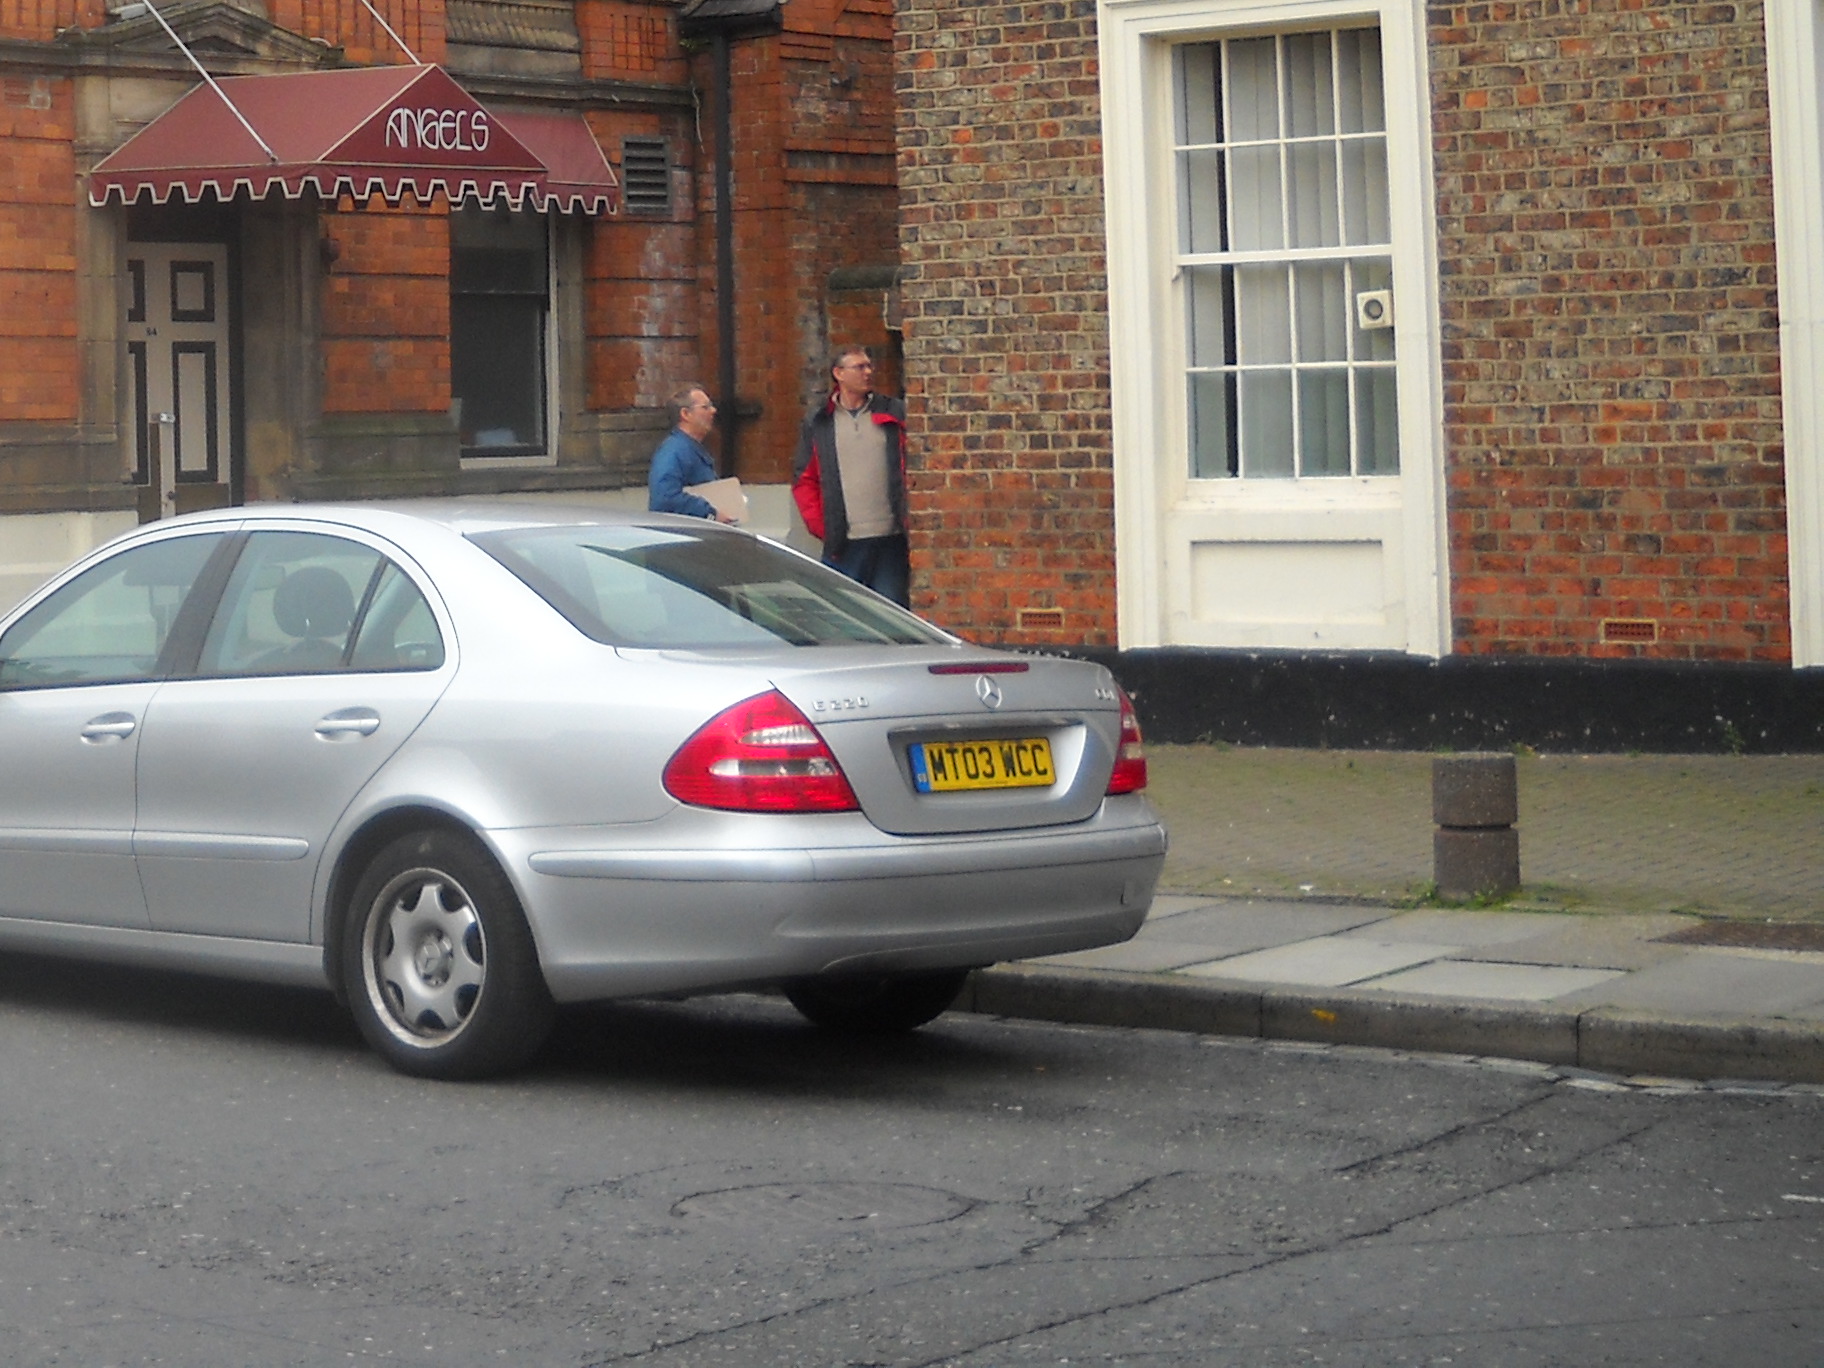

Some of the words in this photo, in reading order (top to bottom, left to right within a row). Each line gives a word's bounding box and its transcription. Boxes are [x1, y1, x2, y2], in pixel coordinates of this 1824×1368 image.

[385, 107, 490, 152] ANGELS
[929, 746, 996, 781] MT03
[999, 744, 1048, 777] WCC
